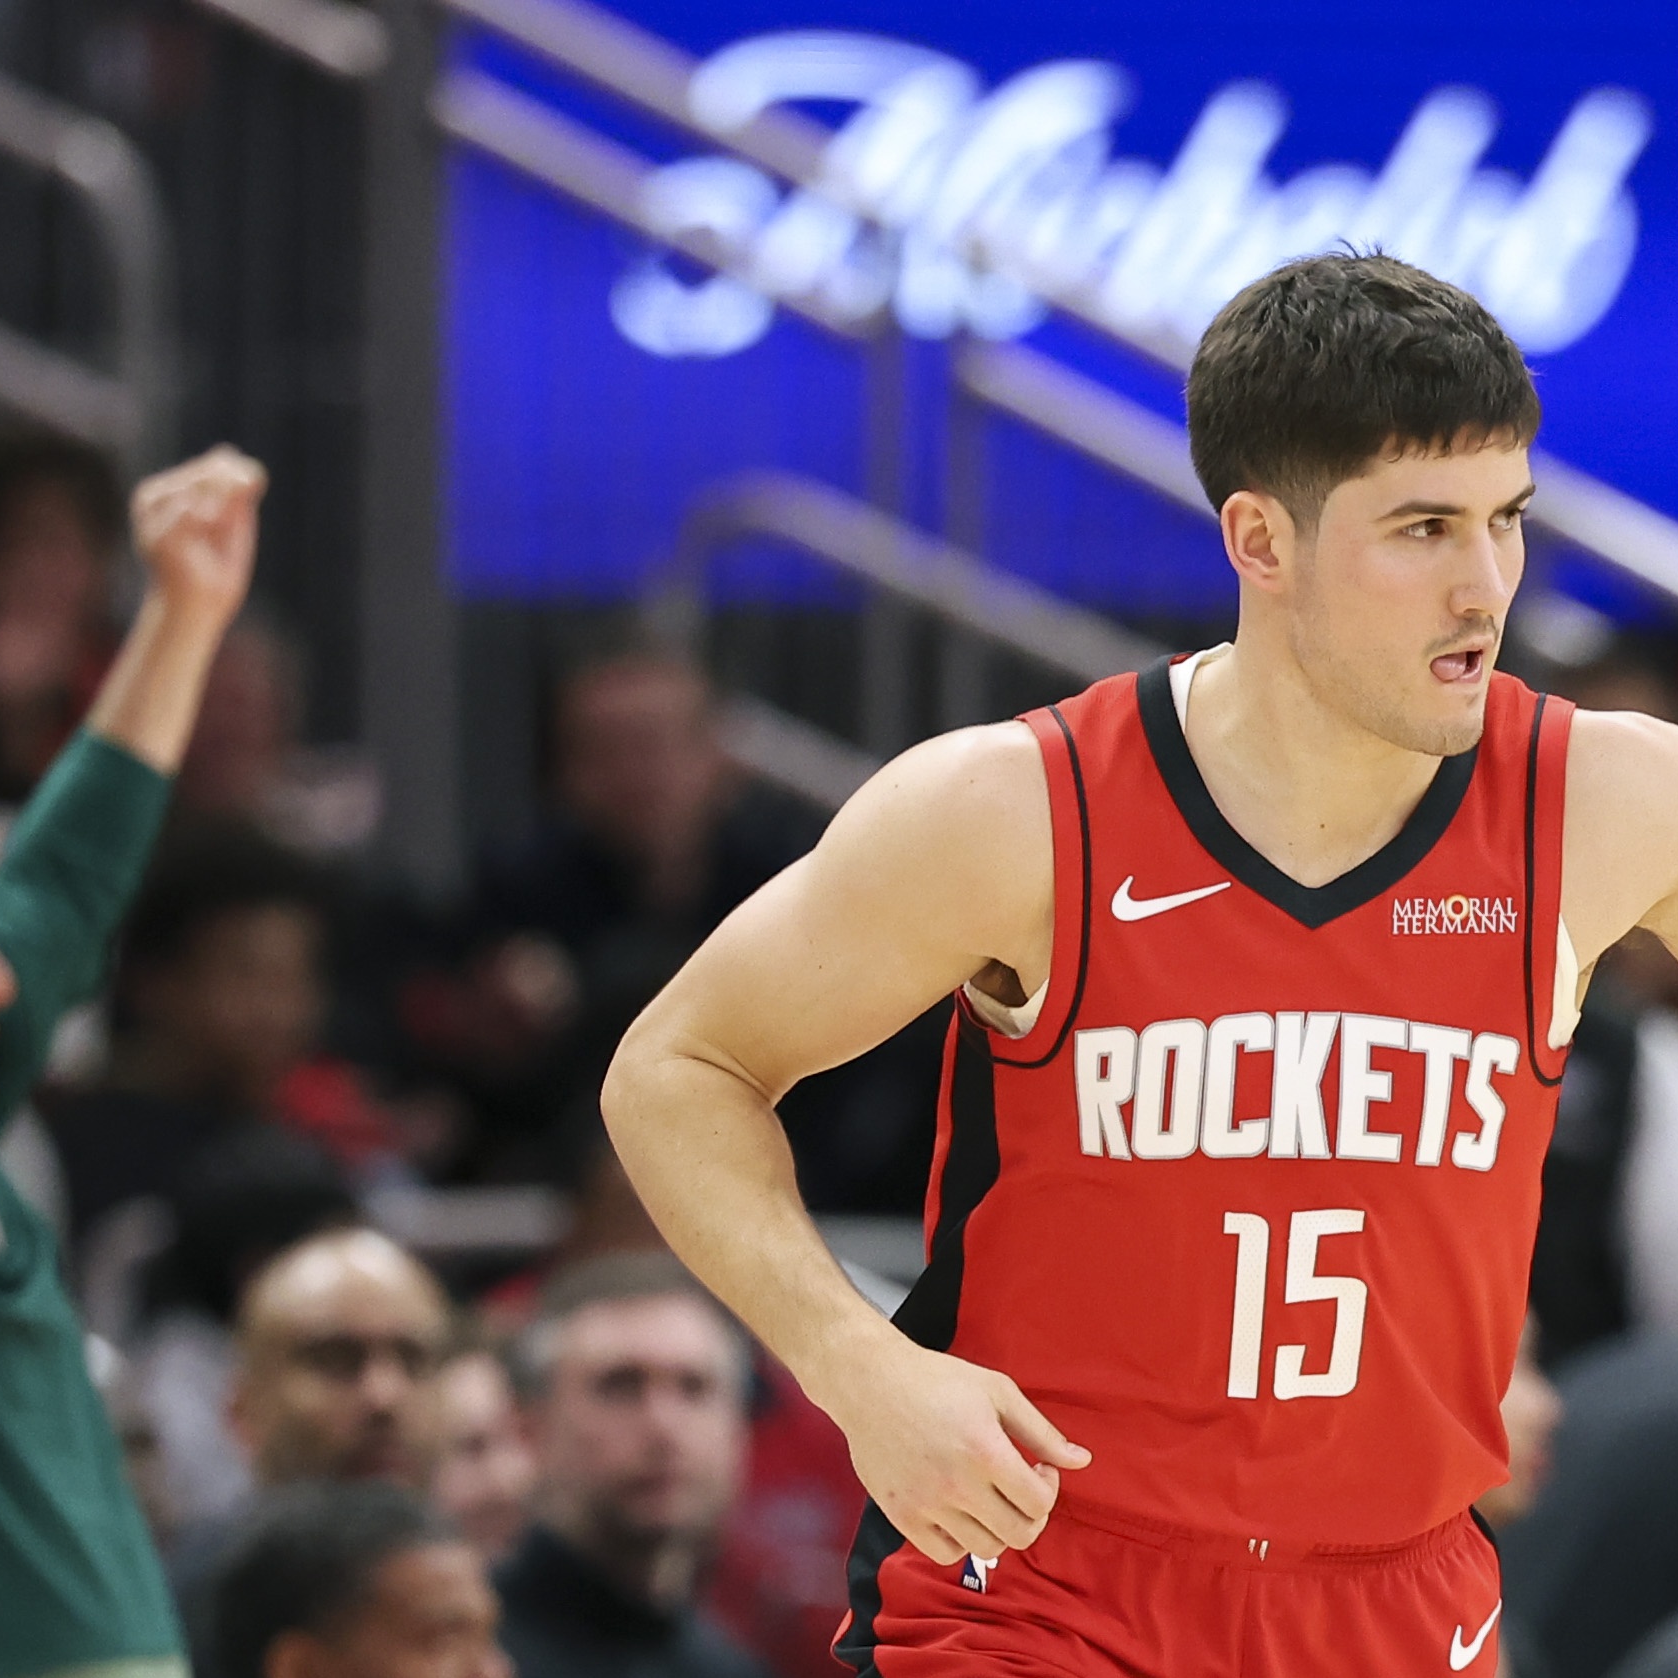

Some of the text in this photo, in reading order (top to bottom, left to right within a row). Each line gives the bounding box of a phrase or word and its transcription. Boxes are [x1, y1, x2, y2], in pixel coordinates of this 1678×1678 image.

[1392, 895, 1518, 919] MEMORIAL
[1392, 914, 1517, 934] HERMANN
[1074, 1011, 1521, 1172] ROCKETS
[1223, 1208, 1368, 1401] 15
[963, 1574, 979, 1590] NBA
